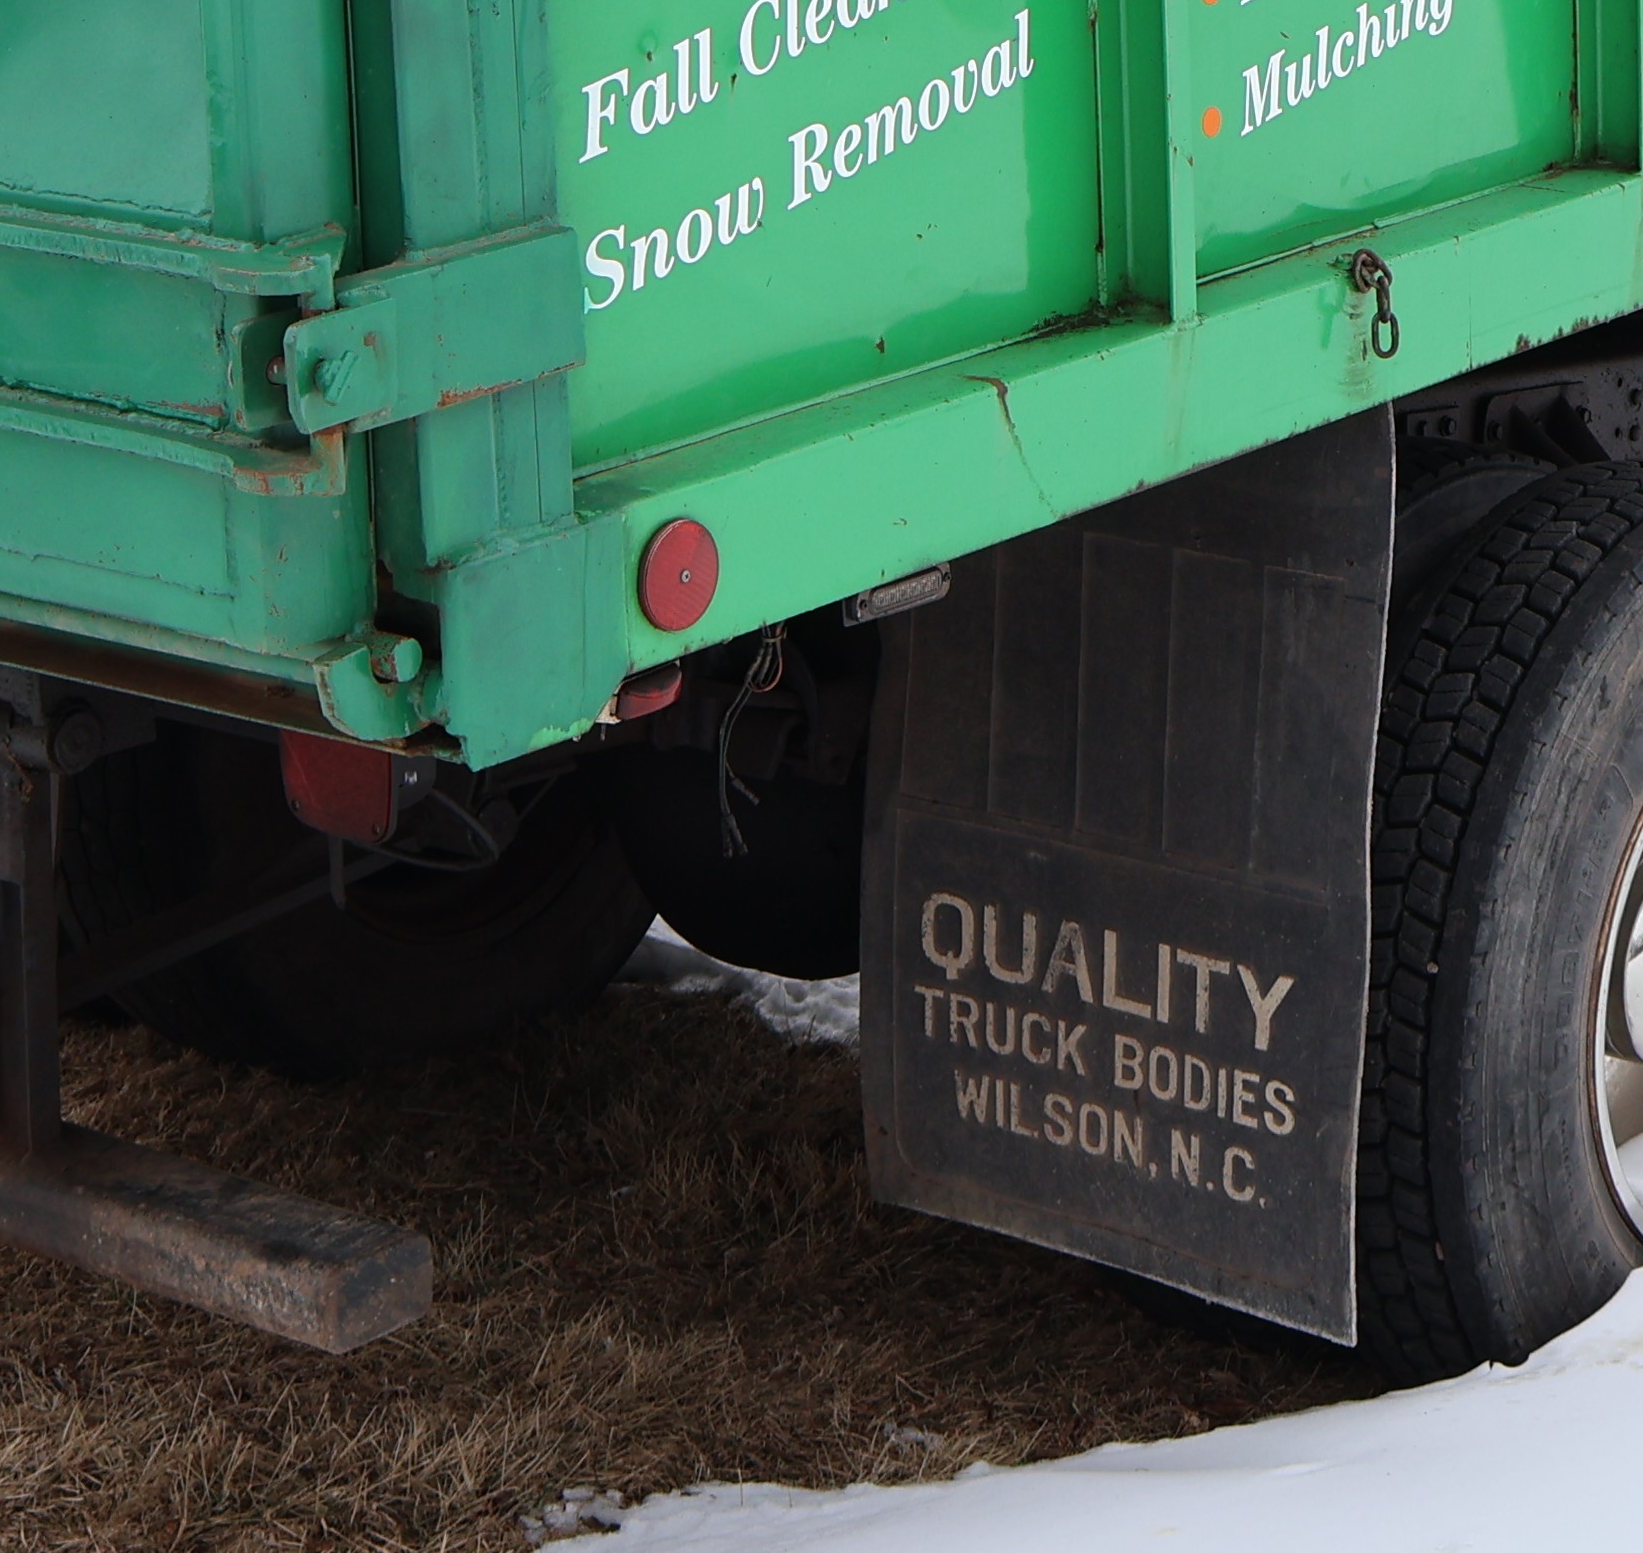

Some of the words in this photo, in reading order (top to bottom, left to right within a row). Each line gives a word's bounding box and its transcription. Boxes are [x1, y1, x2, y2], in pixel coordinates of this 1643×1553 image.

[578, 26, 719, 164] Fall
[583, 176, 765, 315] Snow
[786, 8, 1035, 211] Removal
[921, 892, 1295, 1051] QUALITY
[914, 985, 1087, 1077] TRUCK
[1114, 1033, 1297, 1136] BODIES
